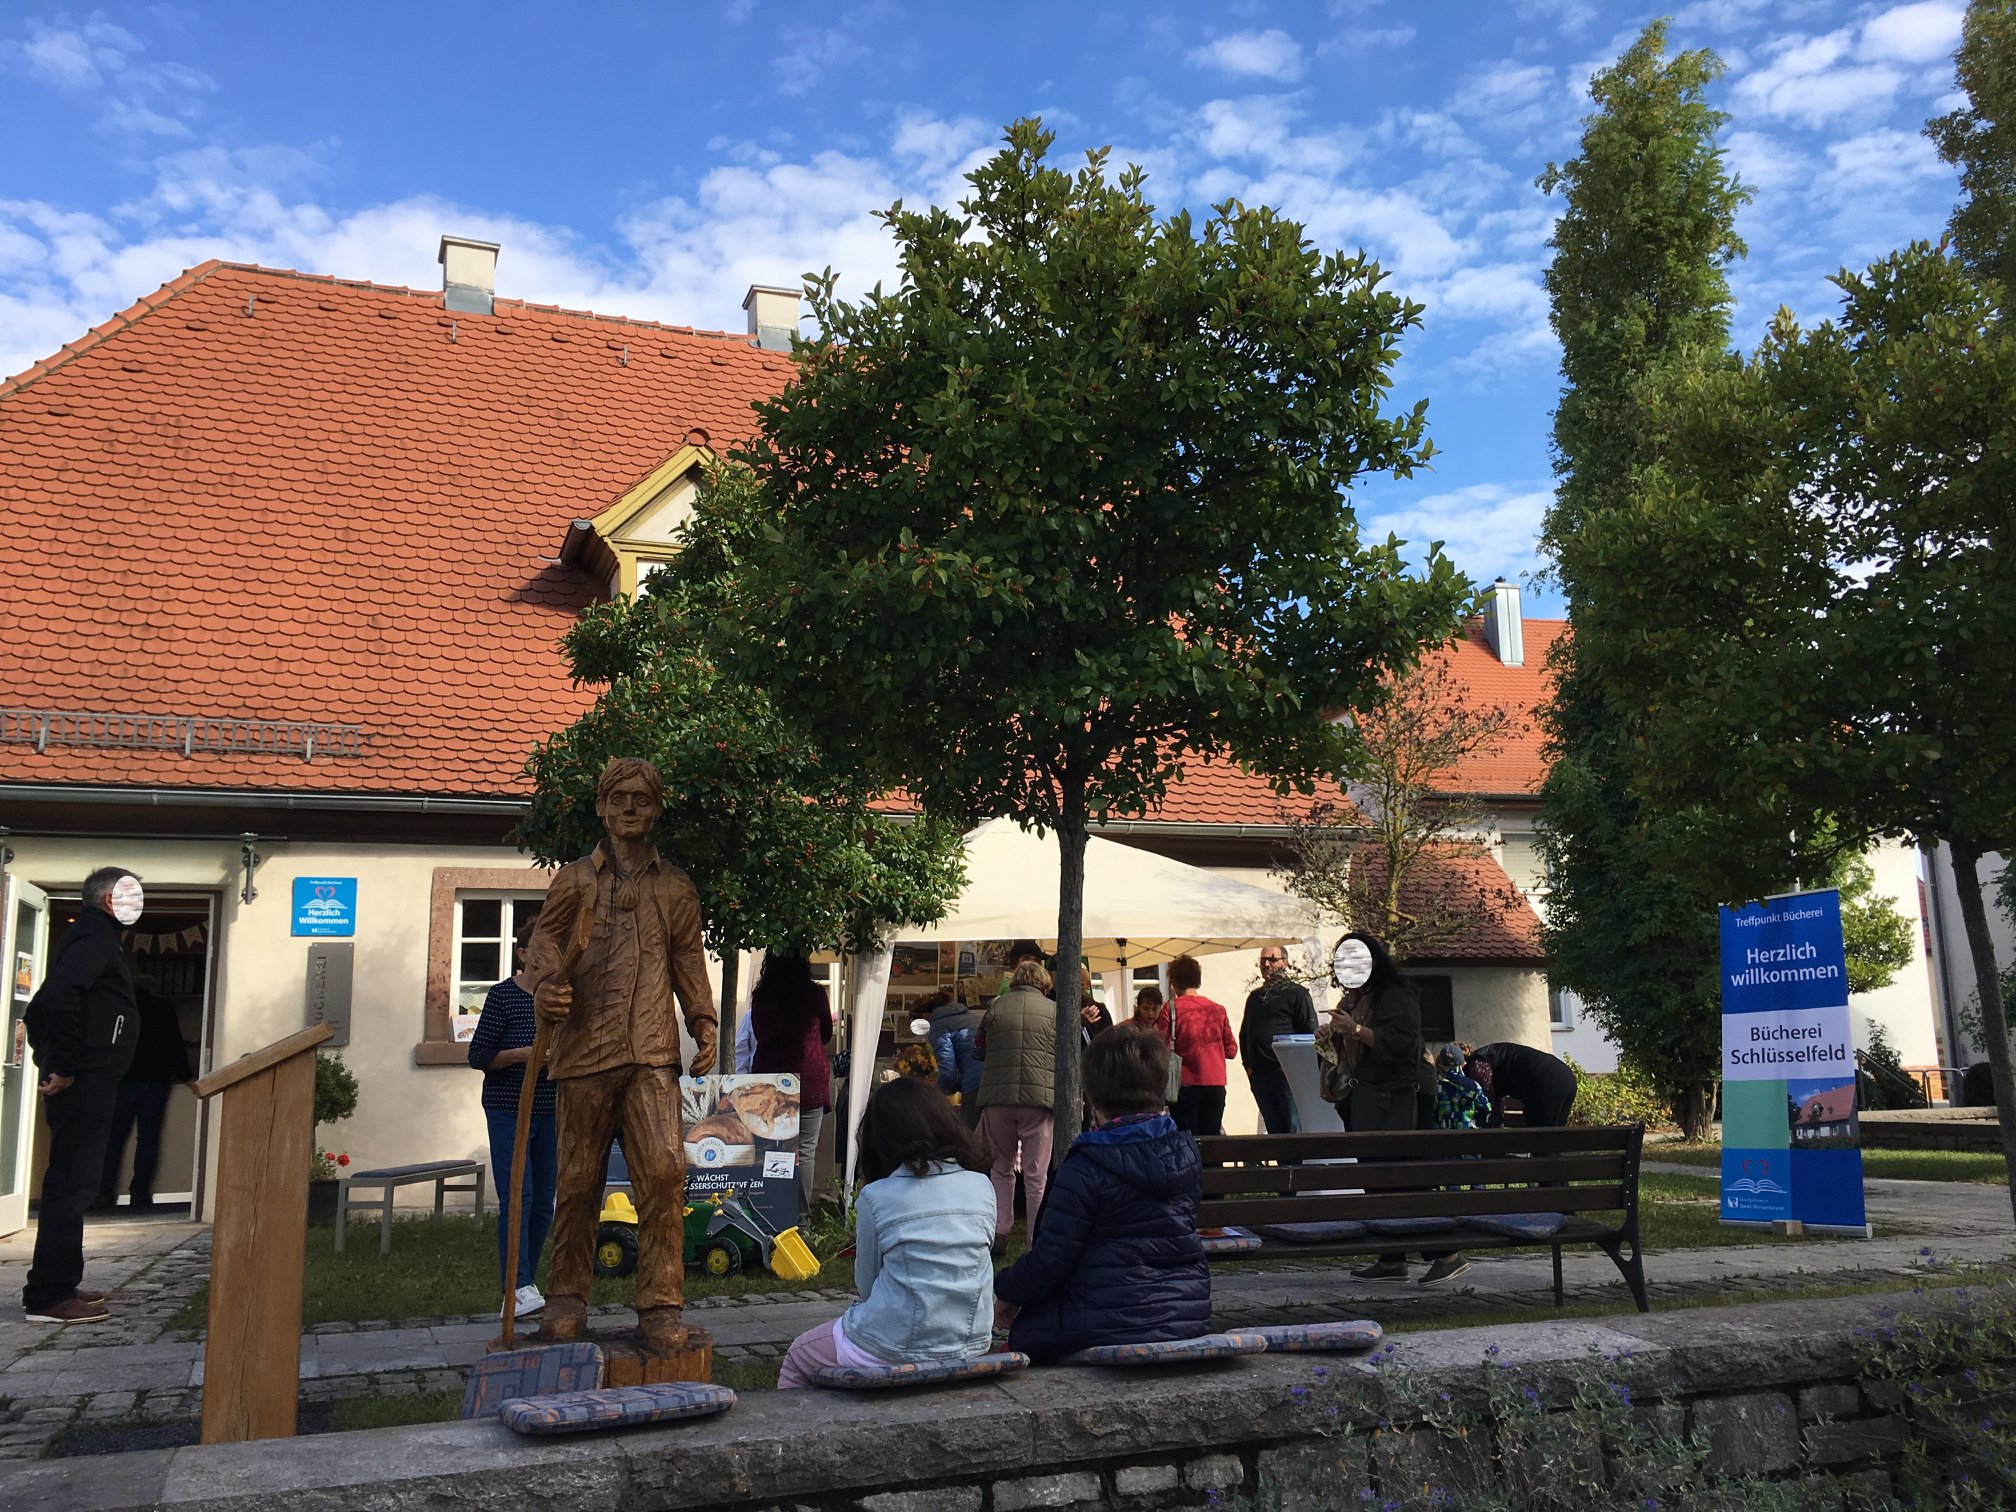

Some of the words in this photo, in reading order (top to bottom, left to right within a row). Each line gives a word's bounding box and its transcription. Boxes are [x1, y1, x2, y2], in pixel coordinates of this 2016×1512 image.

[298, 916, 349, 924] Willkommen
[308, 908, 341, 916] Herzlich
[1735, 913, 1781, 928] Treffpunkt
[1783, 907, 1824, 922] Bücherei
[1746, 941, 1817, 965] Herzlich
[1731, 964, 1838, 987] willkommen
[1750, 1023, 1822, 1042] Bücherei
[1731, 1043, 1846, 1065] Schlüsselfeld
[696, 1173, 730, 1182] WÄCHST
